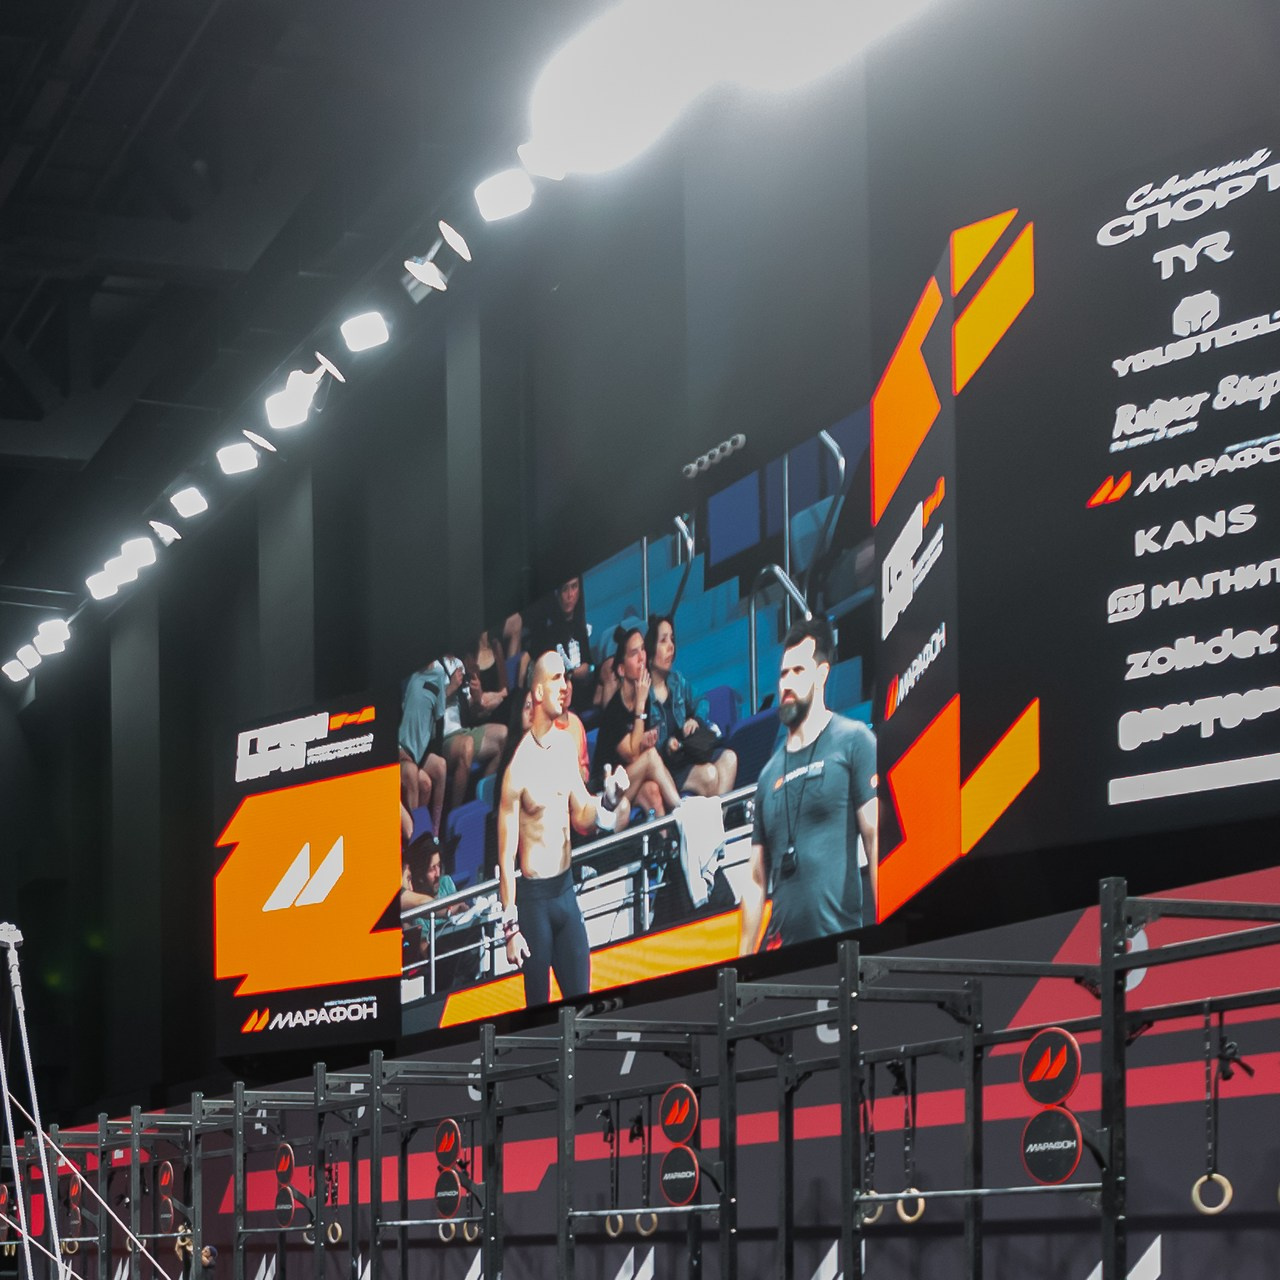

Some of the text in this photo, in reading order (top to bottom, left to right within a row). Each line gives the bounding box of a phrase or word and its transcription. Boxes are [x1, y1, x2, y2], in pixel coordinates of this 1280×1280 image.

[1153, 230, 1234, 280] TYR
[1135, 504, 1257, 557] KANS
[269, 1002, 378, 1031] МАРАФОН
